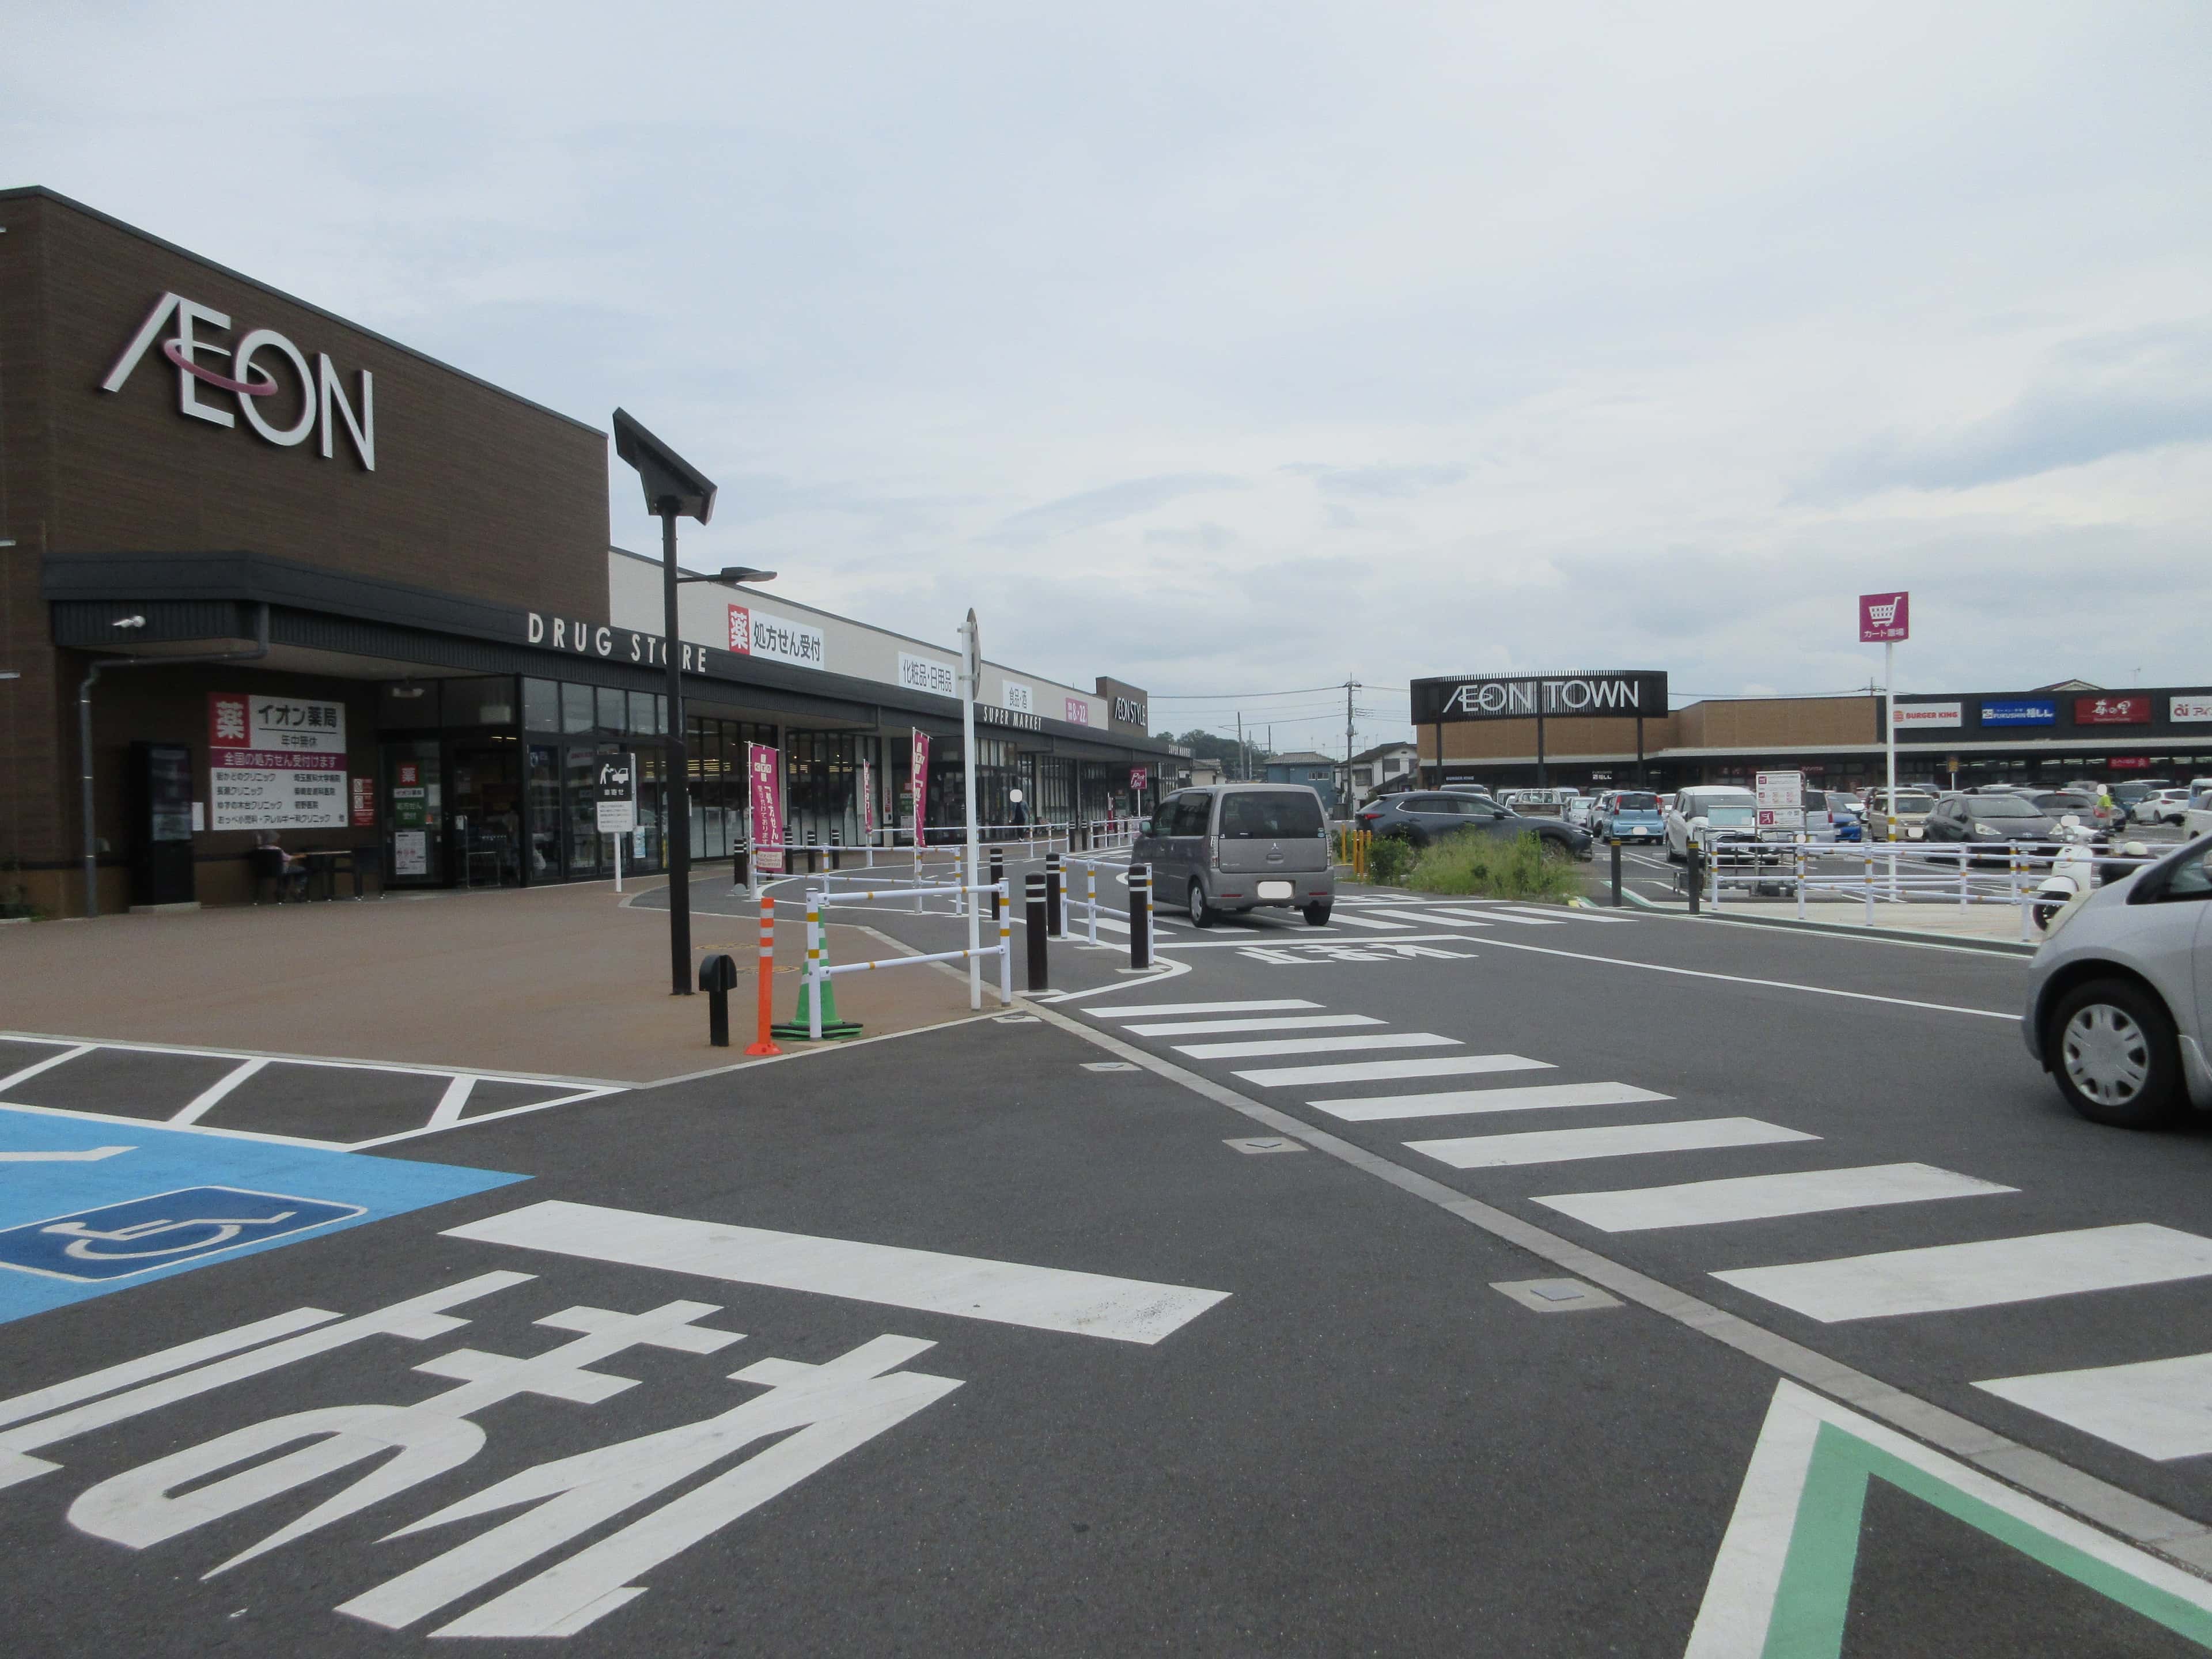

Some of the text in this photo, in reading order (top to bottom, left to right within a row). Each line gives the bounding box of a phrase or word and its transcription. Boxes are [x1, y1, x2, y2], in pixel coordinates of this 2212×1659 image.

[528, 612, 706, 673] DRUG STRE
[730, 611, 748, 650] 薬
[753, 620, 821, 662] 処方せん受付
[1542, 680, 1639, 709] TOWN
[216, 700, 245, 739] 薬
[258, 704, 338, 728] イオン薬局
[983, 706, 1041, 731] SUPER MARKET
[1131, 700, 1146, 726] STYLE
[281, 734, 317, 747] 年中無休
[224, 752, 338, 768] 全国の処方せん受付けます
[1234, 944, 1480, 965] 止まれ
